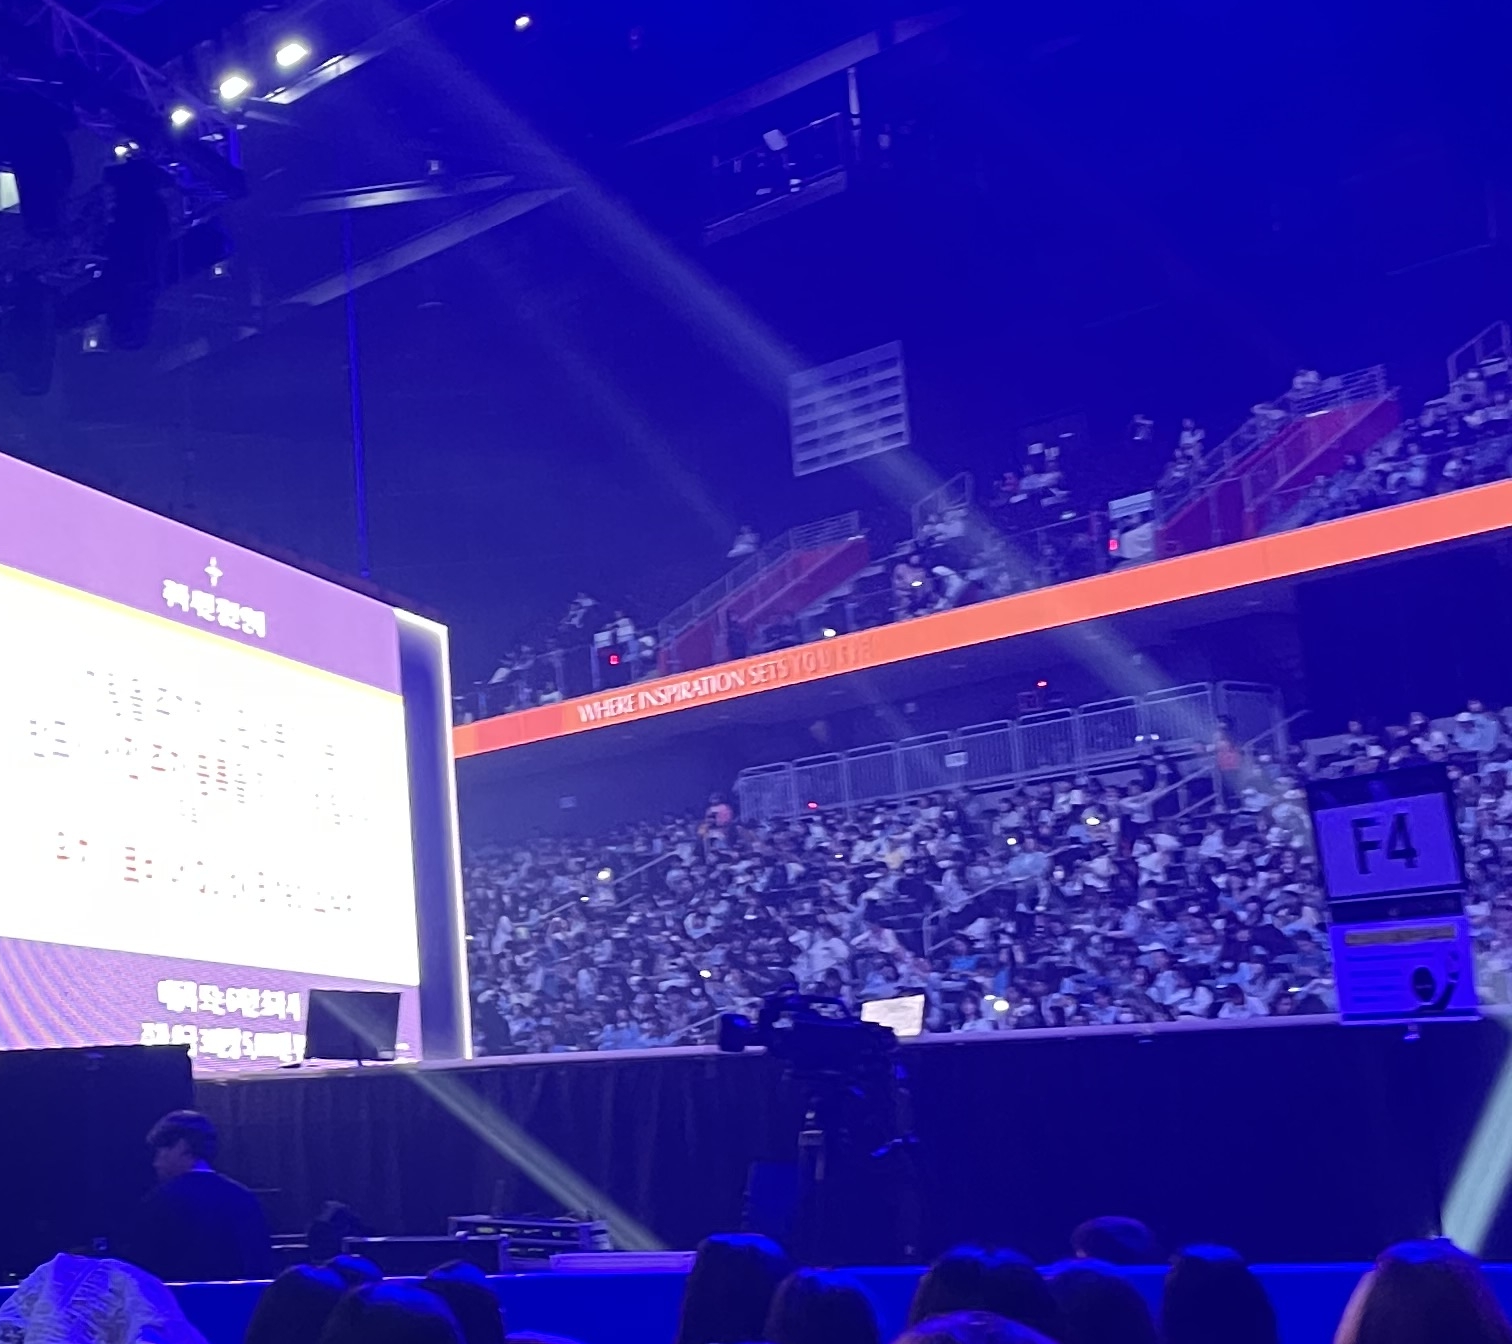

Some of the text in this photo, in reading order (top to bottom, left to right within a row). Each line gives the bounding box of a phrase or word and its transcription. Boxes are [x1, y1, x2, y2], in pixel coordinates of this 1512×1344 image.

[577, 692, 635, 722] WHERE
[637, 668, 746, 710] INSPIRATION
[747, 658, 790, 685] SETS
[1350, 812, 1418, 874] F4
